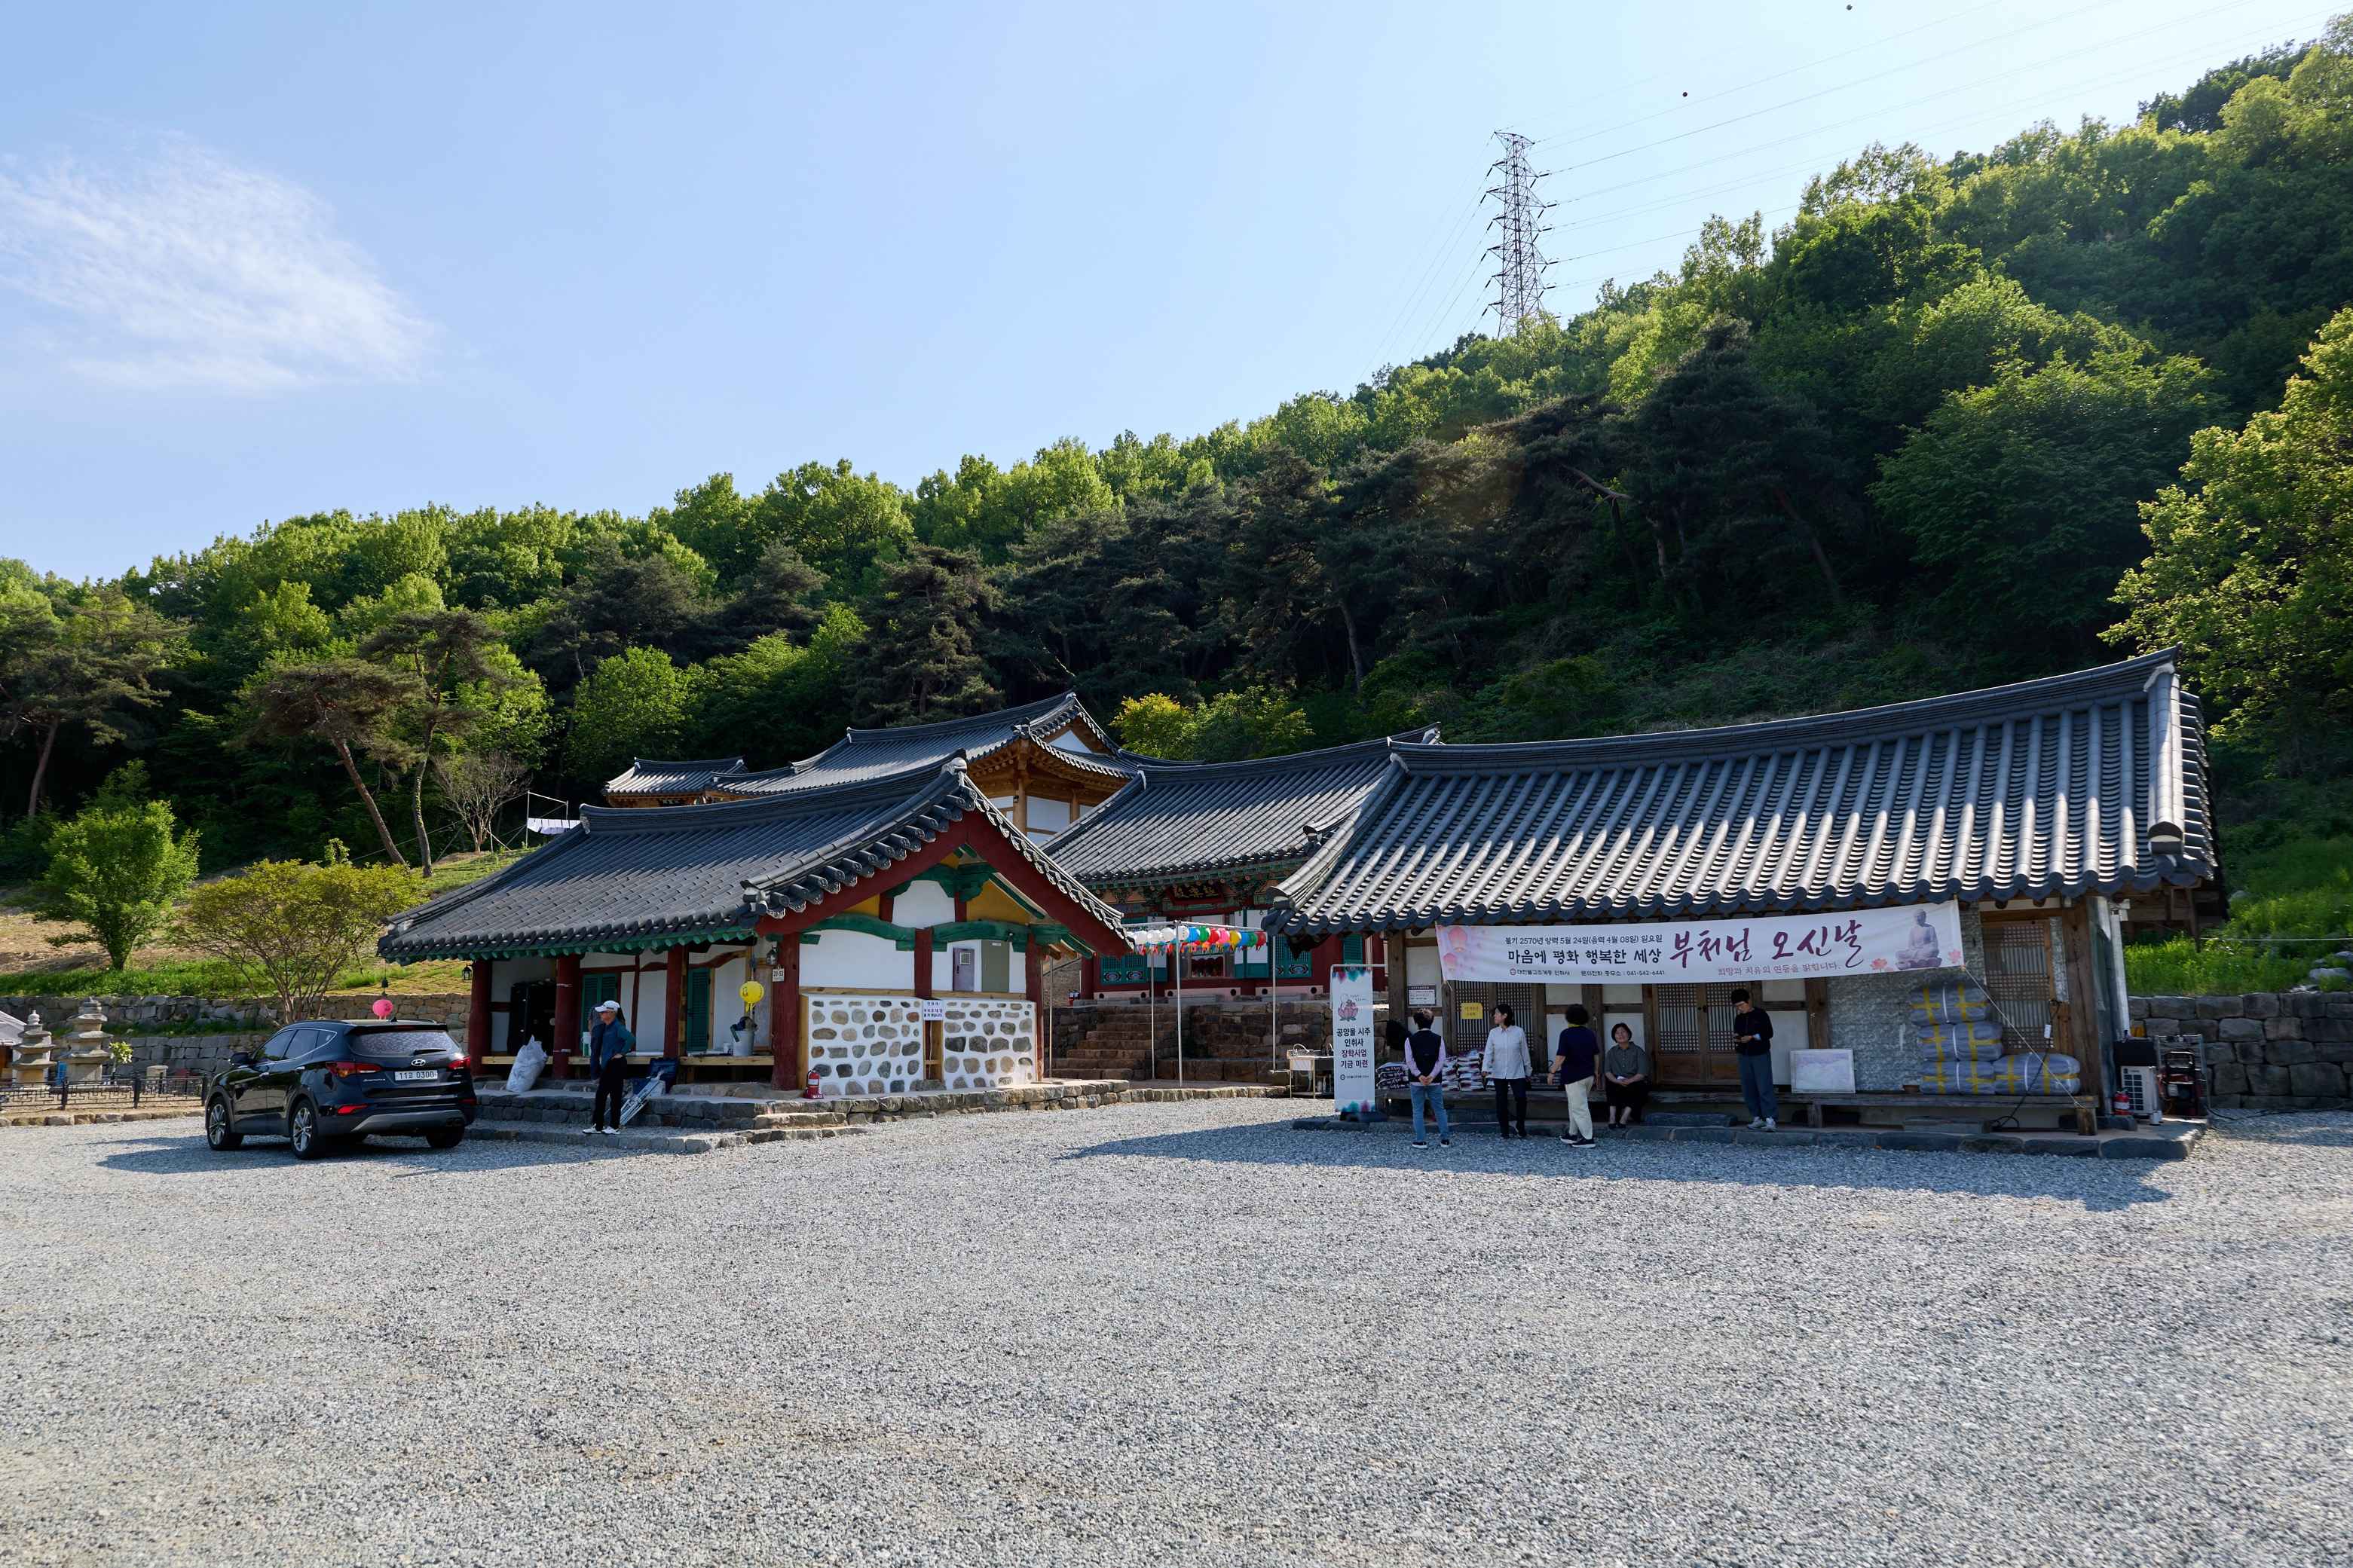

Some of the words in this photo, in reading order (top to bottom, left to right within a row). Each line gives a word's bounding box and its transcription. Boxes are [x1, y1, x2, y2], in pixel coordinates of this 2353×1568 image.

[1505, 937, 1518, 945] 불기
[1519, 937, 1544, 945] 2570년
[1545, 937, 1559, 945] 양력
[1606, 935, 1618, 943] 4월
[1620, 935, 1639, 943] 08일)
[1641, 934, 1663, 943] 일요일
[1669, 928, 1752, 968] 부처님
[1771, 919, 1864, 967] 오신날
[1508, 949, 1547, 964] 마음에
[1553, 949, 1579, 964] 평화
[1585, 949, 1626, 964] 행복한
[1634, 948, 1662, 964] 세상
[1718, 967, 1743, 977] 희망과
[1746, 966, 1771, 976] 치유의
[1773, 964, 1799, 974] 연등을
[1336, 1028, 1356, 1037] 공양물
[1357, 1027, 1371, 1036] 시주
[1345, 1038, 1363, 1047] 인취사
[1342, 1049, 1366, 1058] 장학사업
[1341, 1060, 1353, 1068] 기금
[1355, 1059, 1369, 1068] 마련
